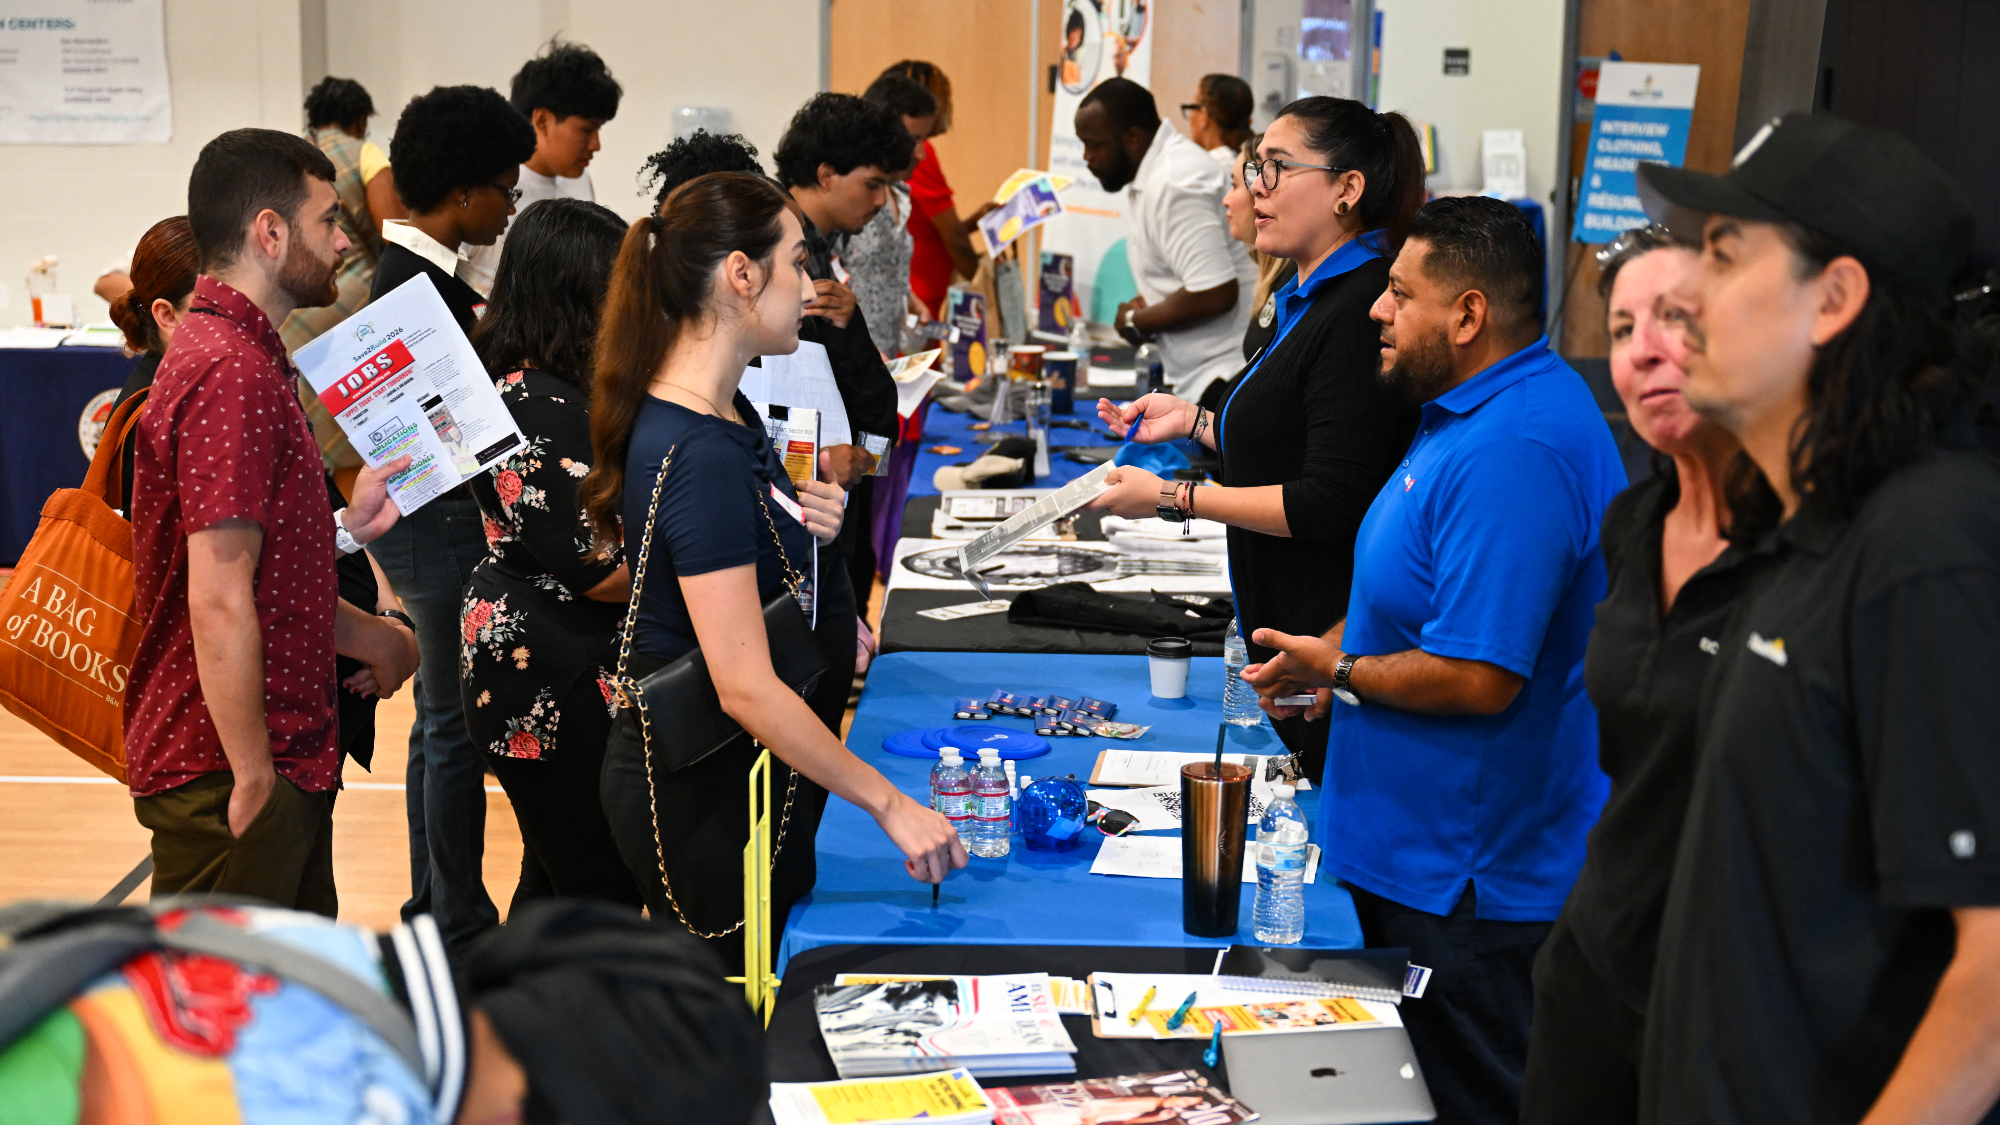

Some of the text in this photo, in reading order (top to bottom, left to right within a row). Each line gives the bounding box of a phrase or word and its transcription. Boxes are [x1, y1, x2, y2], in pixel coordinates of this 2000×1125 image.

[1600, 120, 1669, 137] INTERVIEW
[352, 337, 387, 363] Save2Build
[386, 326, 404, 341] 2026
[337, 352, 394, 399] JOBS
[358, 396, 374, 409] TODAY,
[373, 386, 387, 398] START
[368, 422, 418, 457] APPLICATIONS
[20, 576, 97, 636] A BAG
[6, 613, 130, 693] of BOOKS
[105, 694, 120, 708] B&N
